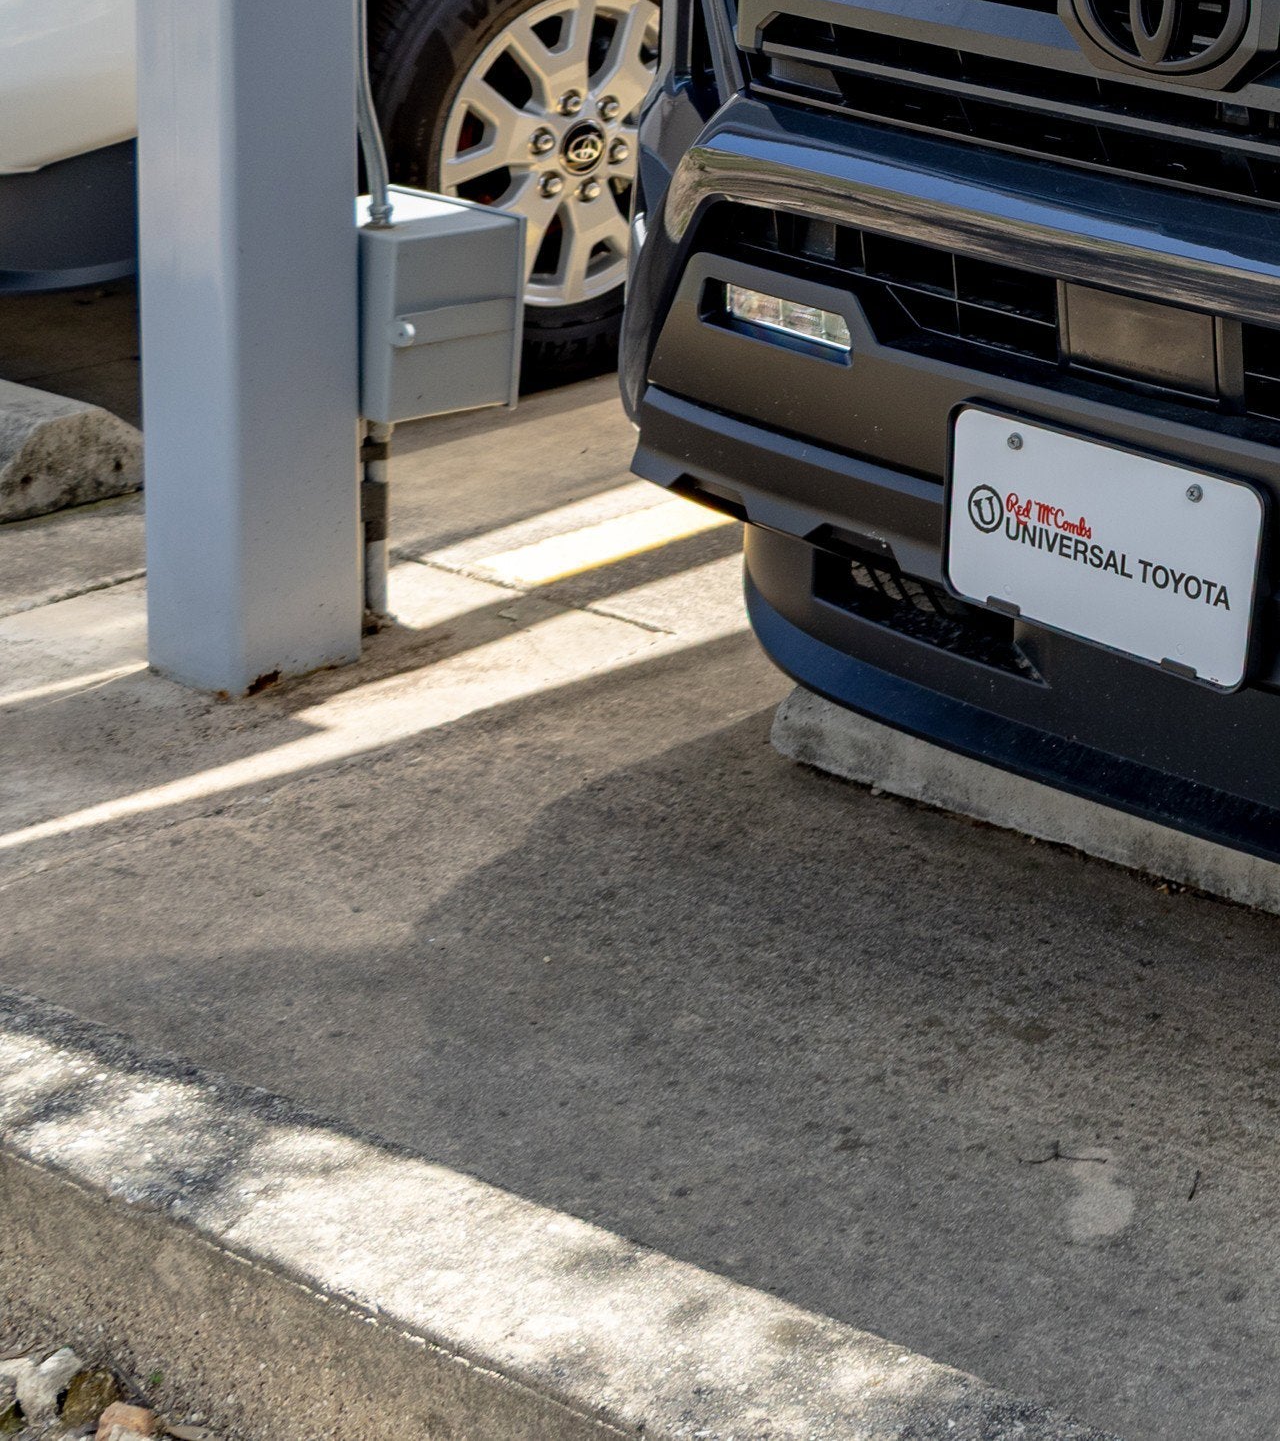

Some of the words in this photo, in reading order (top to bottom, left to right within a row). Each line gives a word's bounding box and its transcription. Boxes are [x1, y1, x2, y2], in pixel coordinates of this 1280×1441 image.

[1006, 492, 1032, 526] Red
[1034, 500, 1092, 540] McCombs
[1005, 516, 1133, 580] UNIVERSAL
[1138, 559, 1231, 611] TOYOTA
